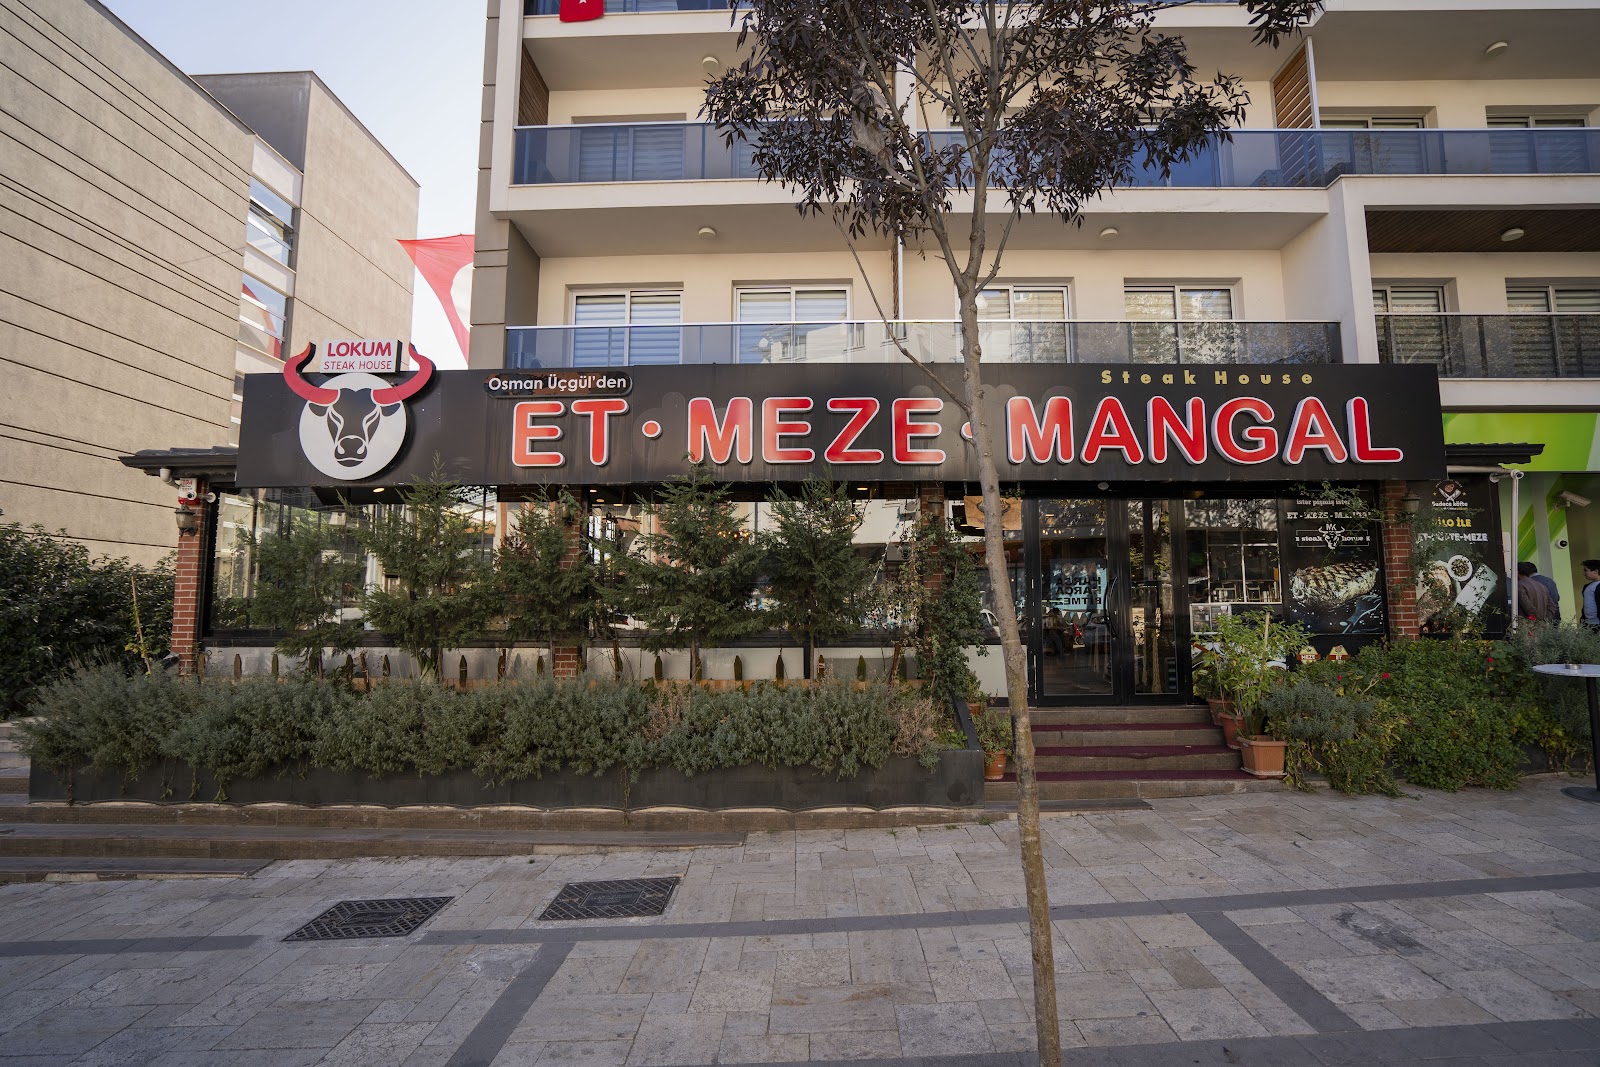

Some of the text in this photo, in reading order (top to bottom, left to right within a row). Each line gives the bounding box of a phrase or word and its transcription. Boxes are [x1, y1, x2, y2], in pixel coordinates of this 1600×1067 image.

[327, 341, 391, 357] LOKUM
[324, 360, 392, 370] STEAK HOUSE
[488, 374, 627, 392] Osman Üçgül'den
[1101, 370, 1313, 385] Steak House
[511, 396, 1405, 467] ET MEZE MANGAL
[1286, 511, 1299, 519] ET
[1456, 516, 1472, 528] İLE
